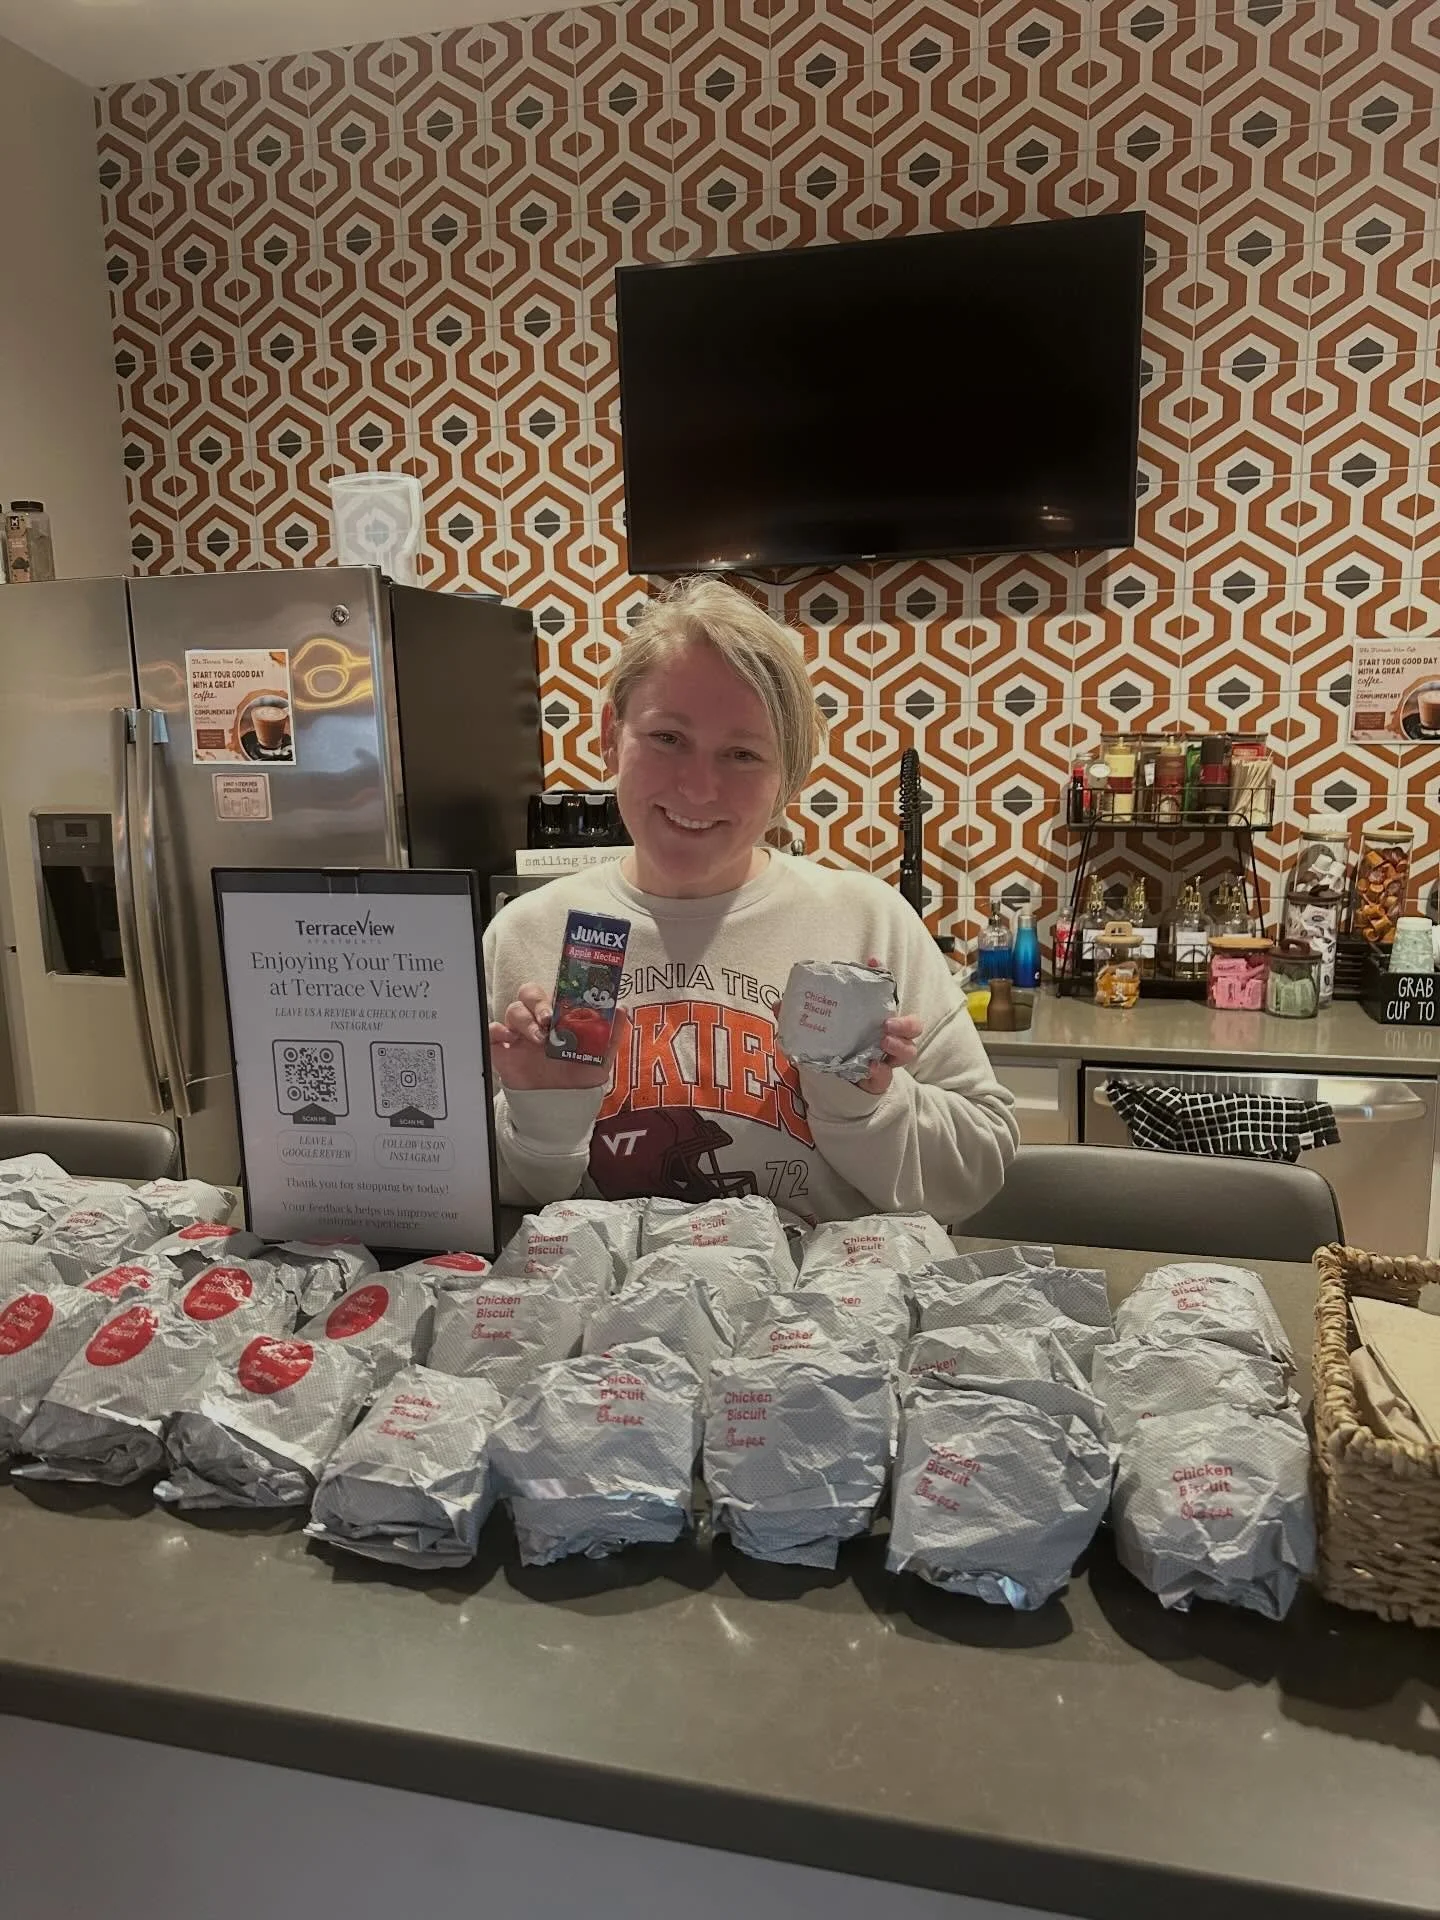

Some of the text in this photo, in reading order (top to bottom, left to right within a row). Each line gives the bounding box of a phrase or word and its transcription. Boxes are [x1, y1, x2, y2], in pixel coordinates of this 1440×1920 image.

[1359, 658, 1380, 666] START
[1402, 657, 1422, 665] GOOD
[192, 671, 212, 679] START
[213, 671, 231, 679] YOUR
[251, 670, 264, 678] DAY
[1358, 667, 1405, 675] WITH A GREAT
[193, 680, 235, 689] WITH A GREAT
[1356, 692, 1401, 700] COMPLIMENTARY
[194, 708, 236, 716] COMPLIMENTARY
[525, 855, 580, 868] smiling
[582, 855, 597, 865] is
[295, 910, 395, 936] TerraceView
[570, 925, 627, 949] JUMEX
[568, 946, 621, 963] Apple Nectar
[251, 951, 445, 974] Enjoying Your Time
[269, 978, 430, 999] at Terrace View?
[617, 963, 784, 1011] GINIA TEC
[1398, 976, 1434, 998] GRAB
[804, 990, 838, 1008] Chicken
[275, 1007, 304, 1017] LEAVE
[323, 1008, 357, 1018] REVIEW
[358, 1008, 365, 1018] &
[366, 1008, 399, 1019] CHECK
[399, 1009, 417, 1019] OUT
[418, 1010, 439, 1020] OUR
[803, 1001, 832, 1017] Biscuit
[1386, 1000, 1435, 1021] CUP TO
[382, 1138, 418, 1149] FOLLOW
[601, 1129, 647, 1156] VT
[282, 1149, 351, 1160] GOOGLE REVIEW
[389, 1151, 440, 1164] INSTAGRAM
[765, 1159, 810, 1198] 72
[286, 1177, 317, 1187] Thank
[318, 1180, 336, 1191] you
[339, 1178, 354, 1189] for
[356, 1181, 400, 1193] stopping
[417, 1184, 450, 1196] today!
[527, 1233, 569, 1244] Chicken
[842, 1235, 885, 1246] Chicken
[527, 1245, 565, 1256] Biscuit
[1171, 1284, 1208, 1297] Biscui
[476, 1295, 521, 1306] Chicken
[476, 1307, 515, 1319] Biscuit
[724, 1391, 772, 1405] Chicken
[727, 1407, 768, 1421] Biscuit
[926, 1459, 970, 1487] Biscuit
[1172, 1464, 1233, 1482] Chicken
[1179, 1480, 1232, 1497] Buit
